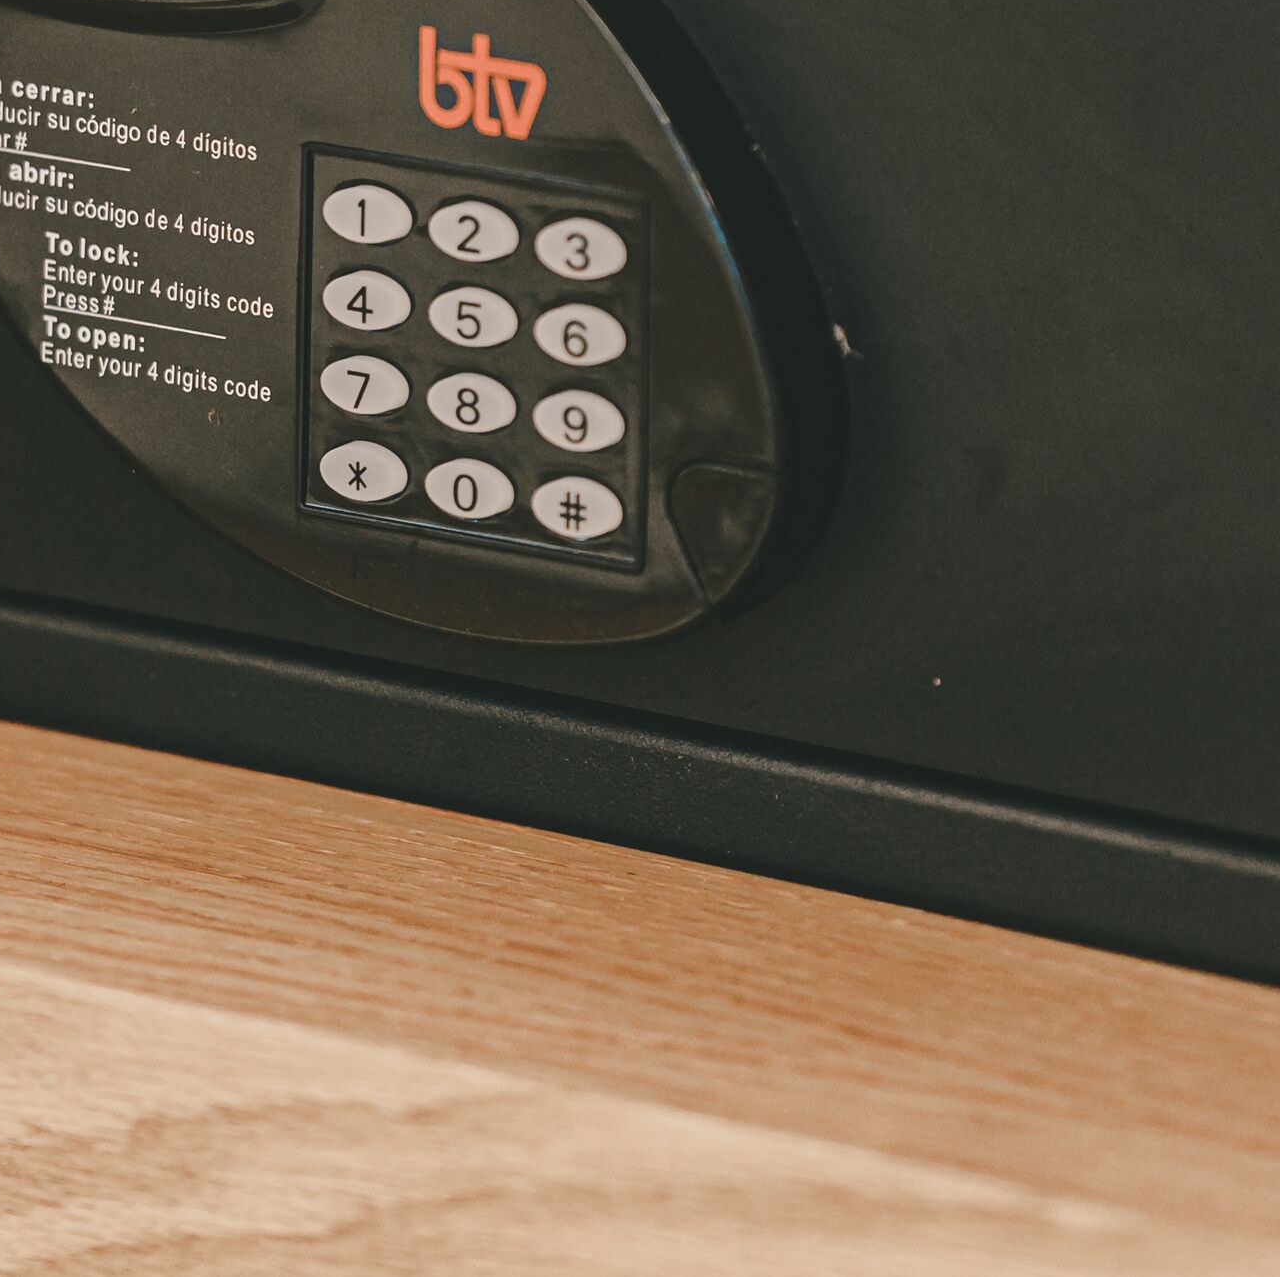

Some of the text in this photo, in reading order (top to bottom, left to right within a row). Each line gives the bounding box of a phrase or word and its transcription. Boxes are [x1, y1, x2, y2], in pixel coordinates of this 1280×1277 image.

[11, 79, 95, 109] cerrar:
[419, 25, 547, 141] btv
[15, 131, 28, 151] #
[47, 112, 70, 131] su
[76, 114, 141, 144] código
[147, 124, 170, 146] de
[176, 129, 186, 149] 4
[193, 132, 257, 161] dígitos
[9, 160, 74, 190] abrir:
[45, 196, 68, 215] su
[73, 198, 139, 228] código
[145, 208, 168, 230] de
[174, 213, 184, 233] 4
[191, 217, 255, 245] dígitos
[356, 198, 591, 272] 1 2 3
[45, 231, 139, 267] To lock:
[43, 258, 274, 319] Enter your 4 digits code
[43, 284, 115, 316] Press #
[43, 314, 145, 352] To open:
[346, 285, 589, 358] 4 5 6
[41, 341, 271, 402] Enter your 4 digits code
[346, 370, 588, 443] 7 8 9
[453, 473, 477, 512] 0
[558, 491, 588, 530] #
